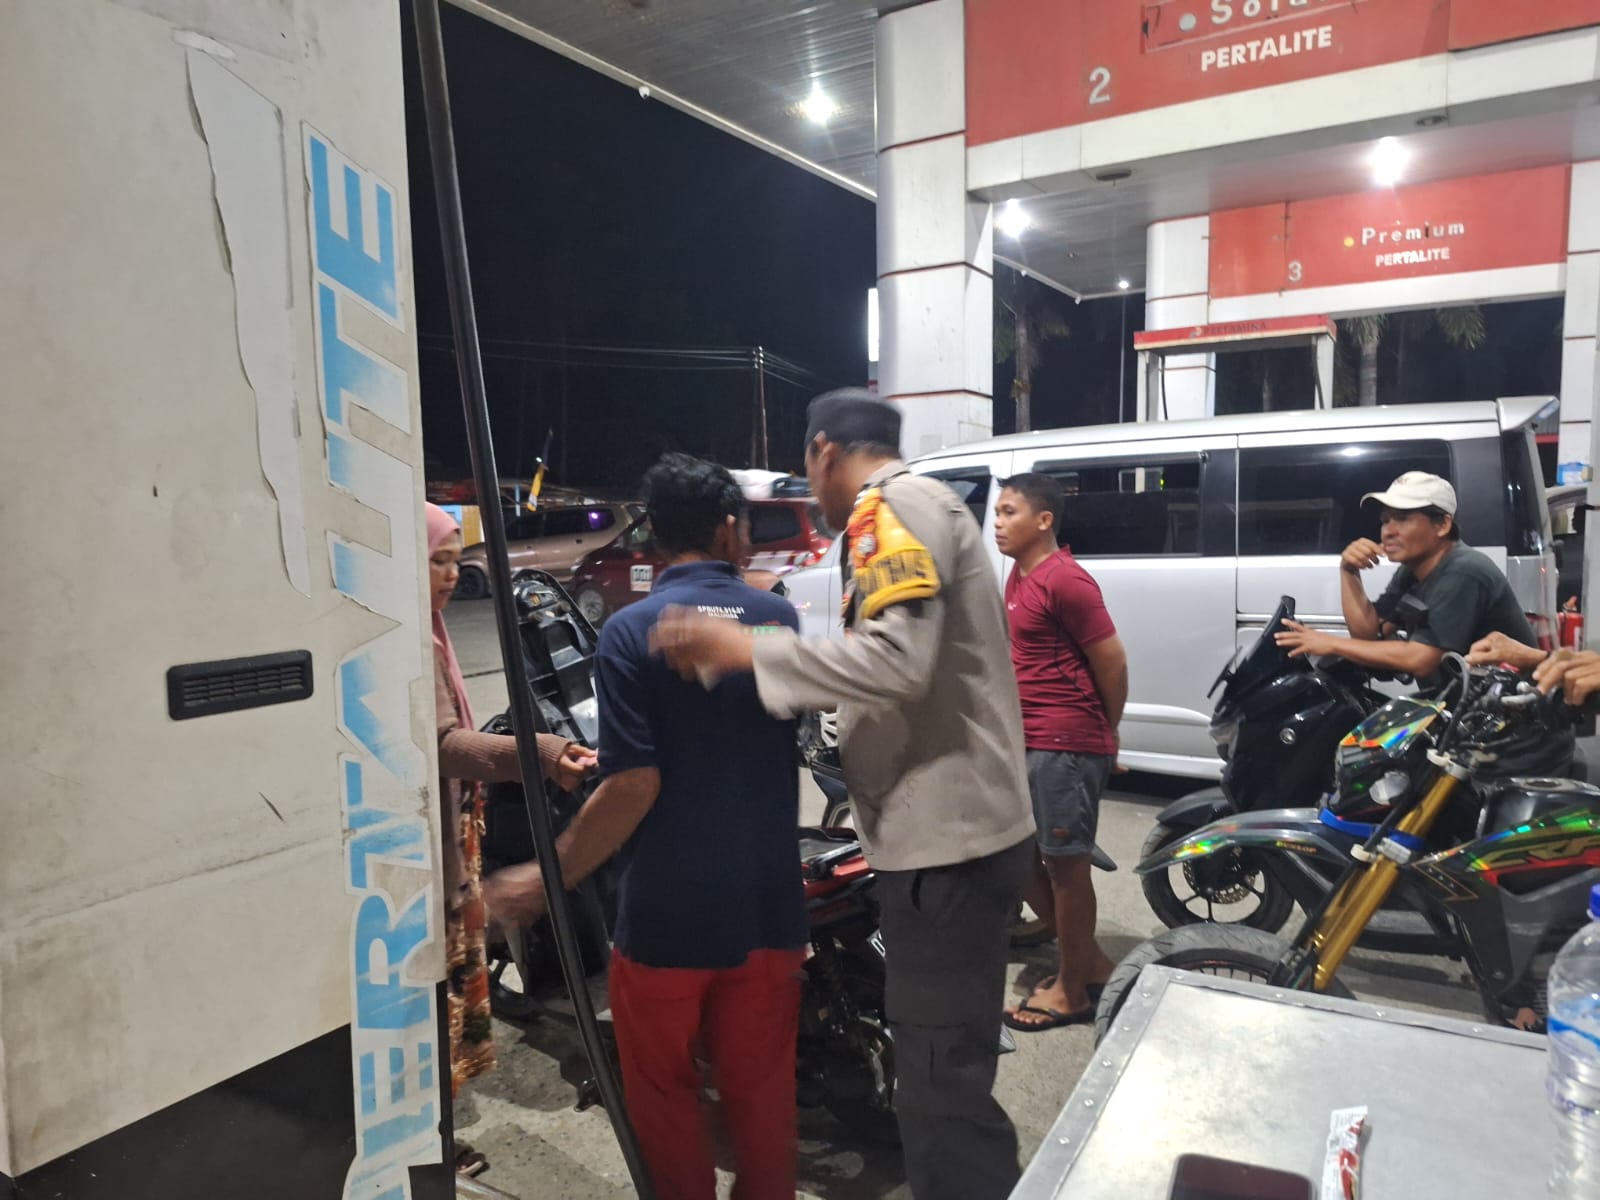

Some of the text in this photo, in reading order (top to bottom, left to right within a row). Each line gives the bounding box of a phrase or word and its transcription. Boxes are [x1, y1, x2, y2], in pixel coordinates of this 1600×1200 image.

[1201, 25, 1333, 73] PERTALITE
[1088, 66, 1111, 105] 2
[1361, 221, 1465, 246] Premium
[1375, 247, 1451, 267] PERTALITE
[1288, 260, 1302, 282] 3
